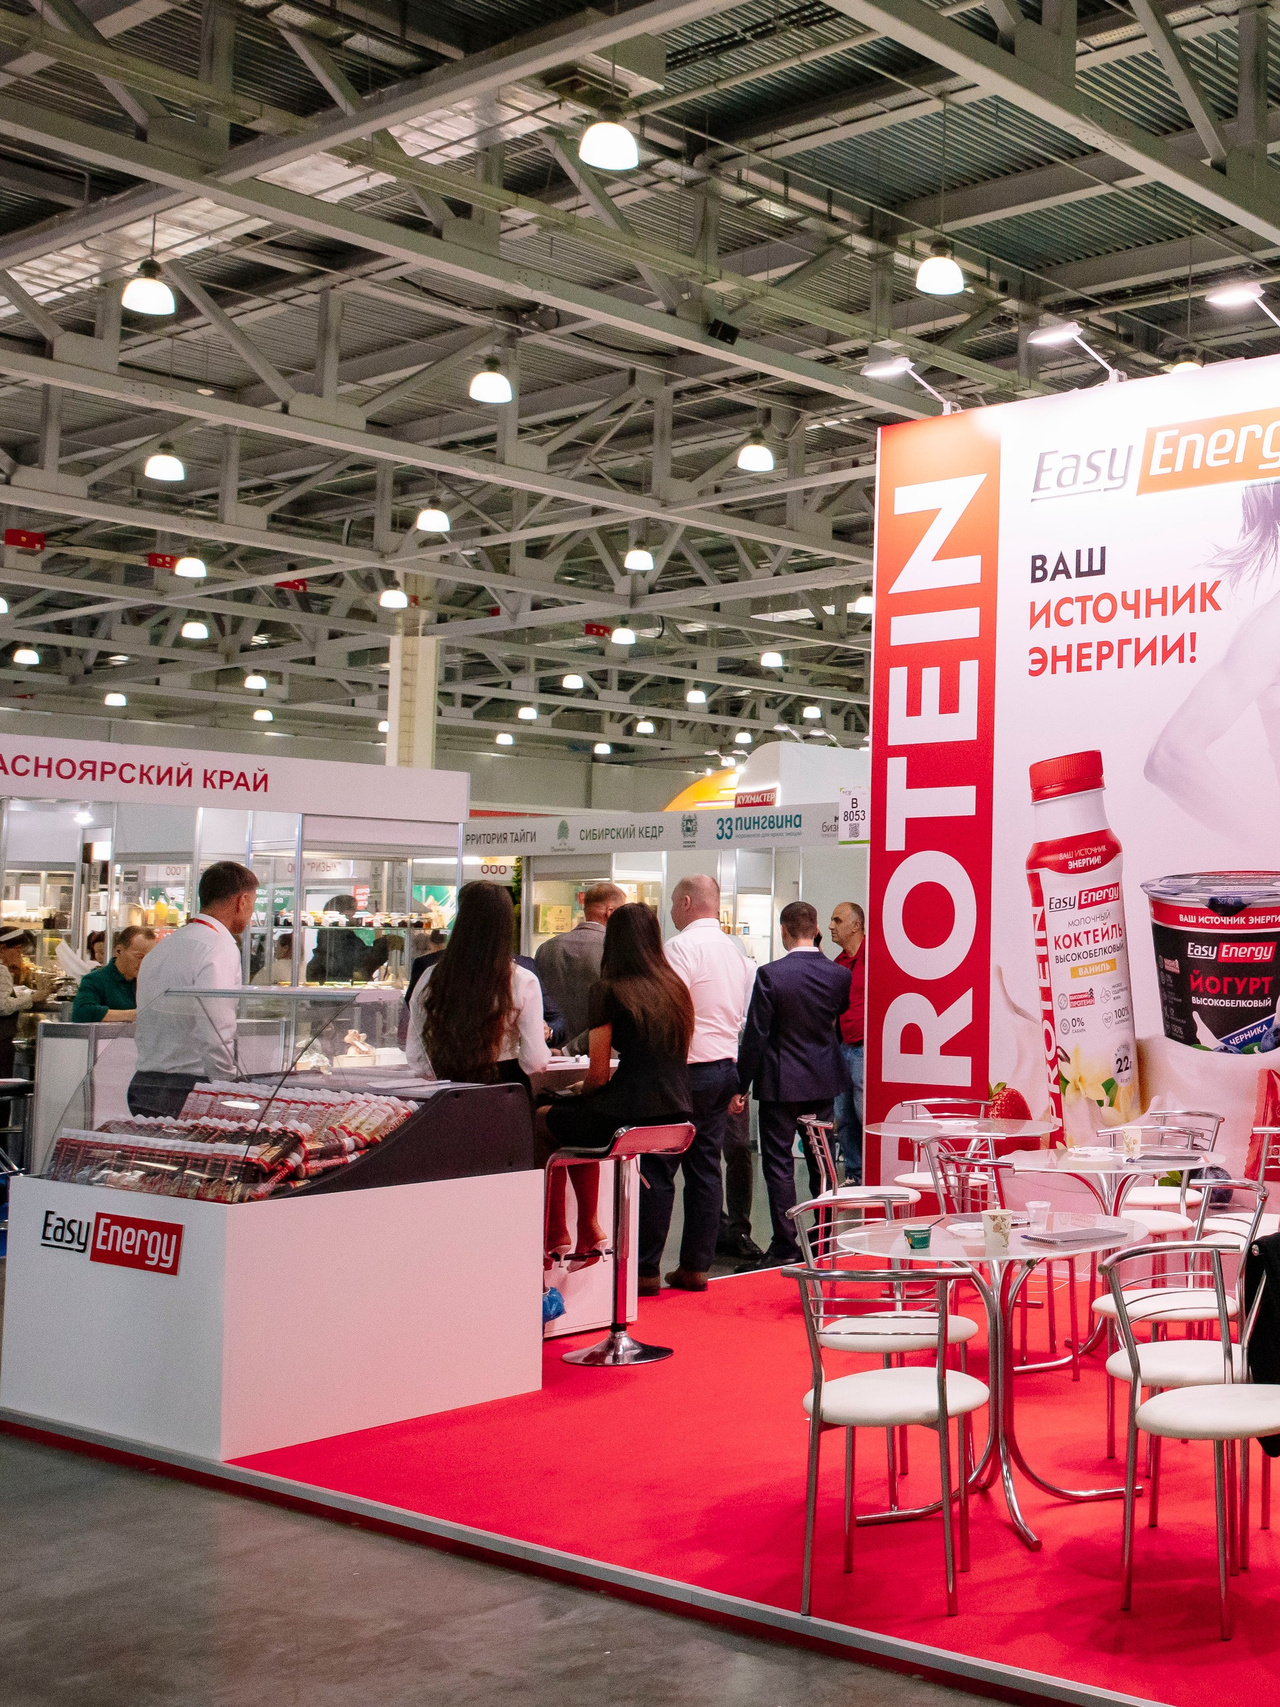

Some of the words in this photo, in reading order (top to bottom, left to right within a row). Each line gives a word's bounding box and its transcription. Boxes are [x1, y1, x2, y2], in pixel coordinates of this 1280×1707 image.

[1031, 444, 1134, 501] Easy
[1030, 546, 1106, 584] ВАШ
[1029, 580, 1222, 631] ИСТОЧНИК
[1028, 632, 1198, 677] ЭНЕРГИИ!
[203, 767, 269, 792] КРАЙ
[736, 792, 775, 805] КУХМАСТЕР
[735, 814, 802, 831] пингвина
[843, 810, 866, 821] 8053
[509, 830, 536, 843] ТАЙГИ
[579, 826, 636, 841] СИБИРСКИЙ
[638, 825, 664, 840] КЕДР
[716, 817, 733, 840] 33
[1059, 852, 1074, 861] ВАШ
[1075, 845, 1107, 857] ИСТОЧНИК
[1068, 855, 1102, 869] ЭНЕРГИИ!
[1049, 896, 1077, 912] Easy
[1081, 885, 1119, 905] Energy
[1068, 909, 1111, 928] МОЛОЧНЫЙ
[1179, 914, 1196, 923] ВАШ
[1198, 916, 1246, 925] ИСТОЧНИК
[1053, 922, 1123, 950] КОКТЕЙЛЬ
[1055, 940, 1125, 964] ВЫСОКОБЕЛКОВЫЙ
[1187, 942, 1217, 960] Easy
[1221, 944, 1273, 961] Energy
[1078, 963, 1111, 976] ВАНИЛЬ
[1190, 970, 1274, 995] ЙОГУРТ
[1191, 996, 1272, 1008] ВЫСОКОБЕЛКОВЫЙ
[1071, 1016, 1085, 1028] 0%
[1229, 1024, 1268, 1046] ЧЕРНИКА
[41, 1210, 91, 1254] Easy
[96, 1218, 179, 1269] Energy
